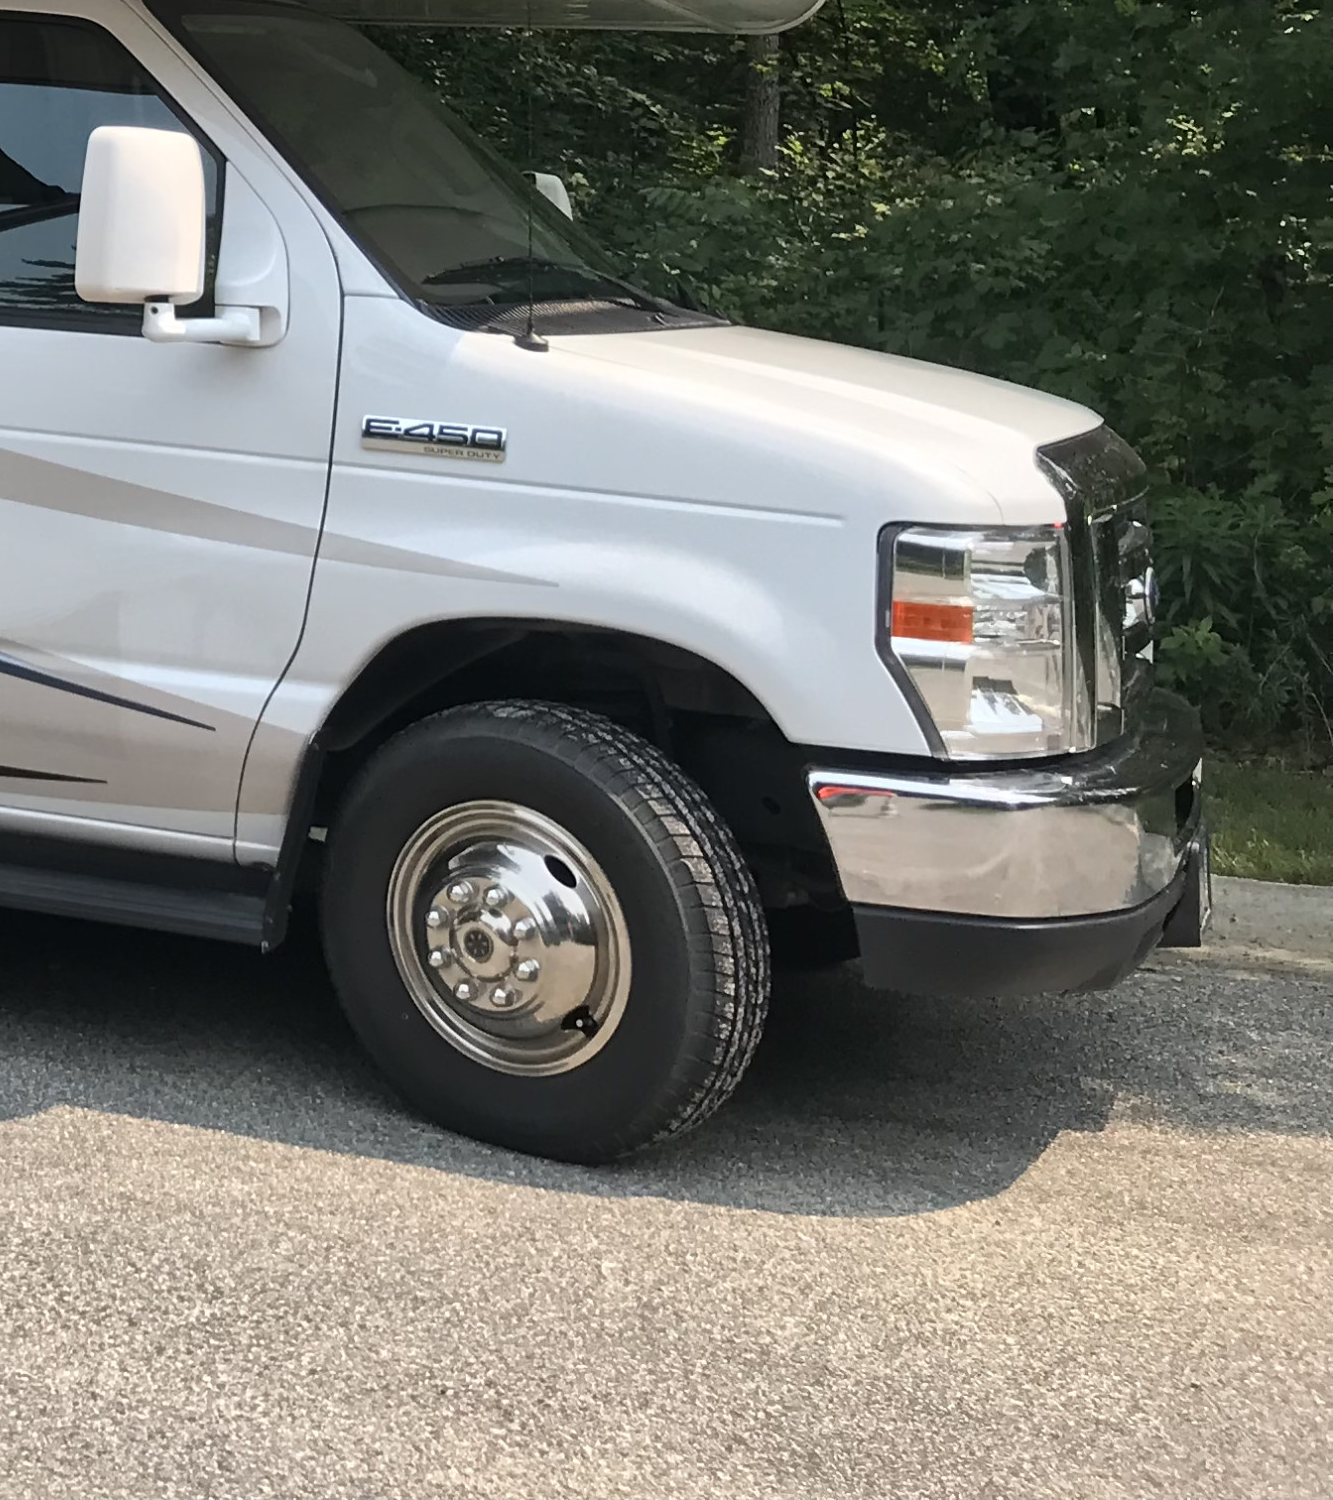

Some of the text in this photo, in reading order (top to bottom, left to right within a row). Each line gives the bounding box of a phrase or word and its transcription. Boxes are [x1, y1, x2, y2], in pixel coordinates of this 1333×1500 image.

[363, 417, 504, 450] E-450
[423, 446, 501, 460] SUPER DUTY
